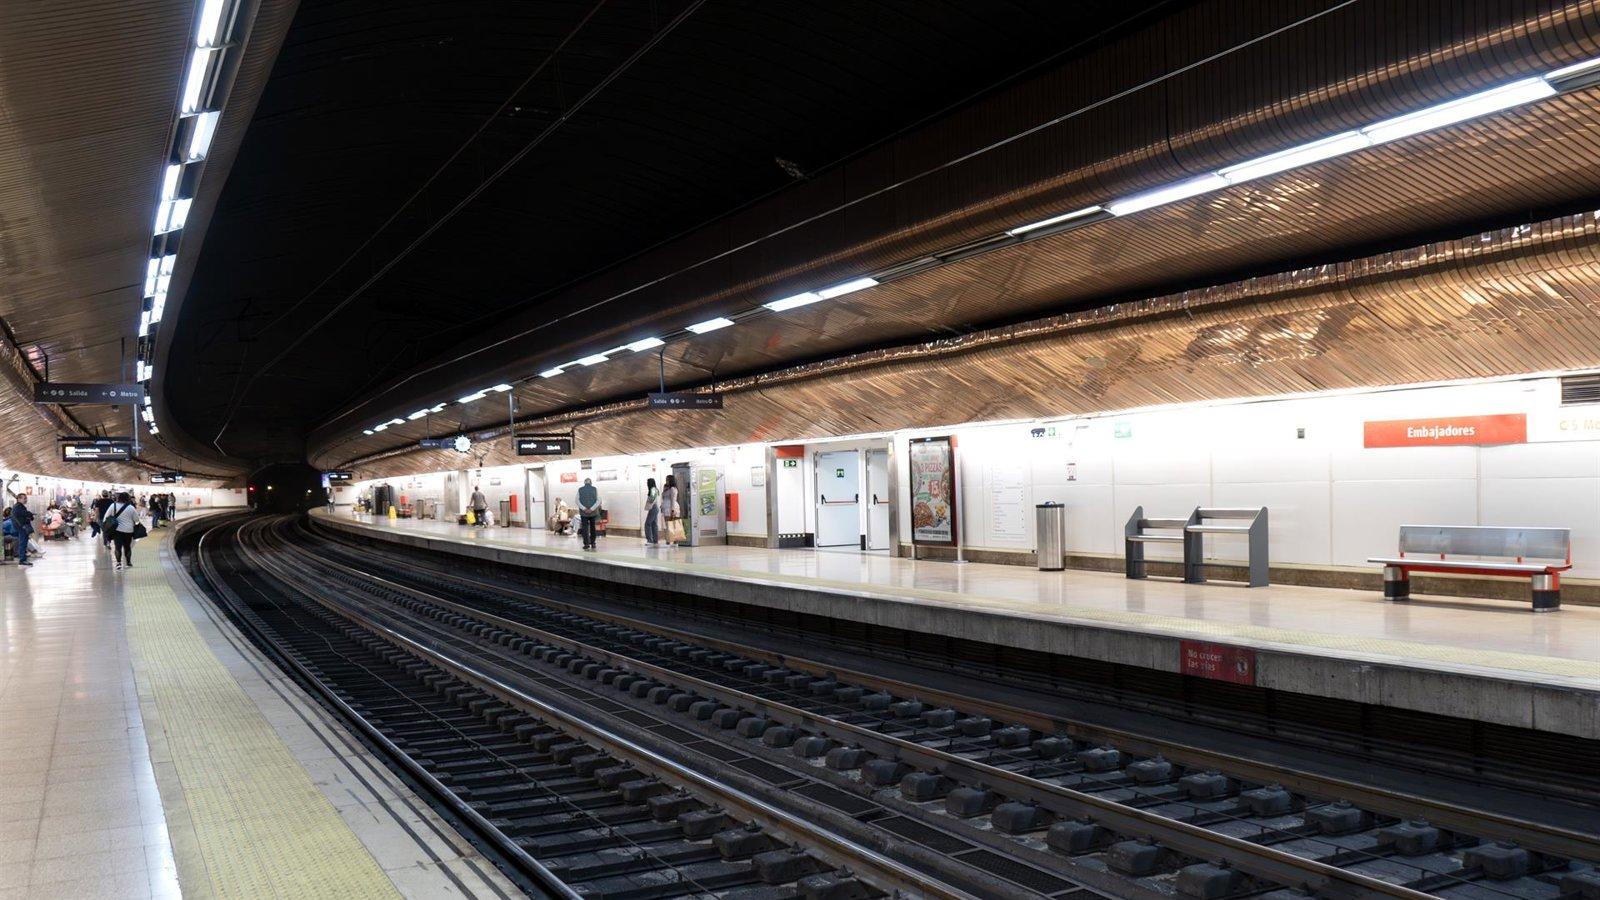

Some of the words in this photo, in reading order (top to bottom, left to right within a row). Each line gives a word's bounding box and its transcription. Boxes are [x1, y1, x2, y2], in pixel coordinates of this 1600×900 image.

[1407, 425, 1475, 440] Embajadores
[1188, 649, 1198, 658] No
[1188, 658, 1199, 669] las
